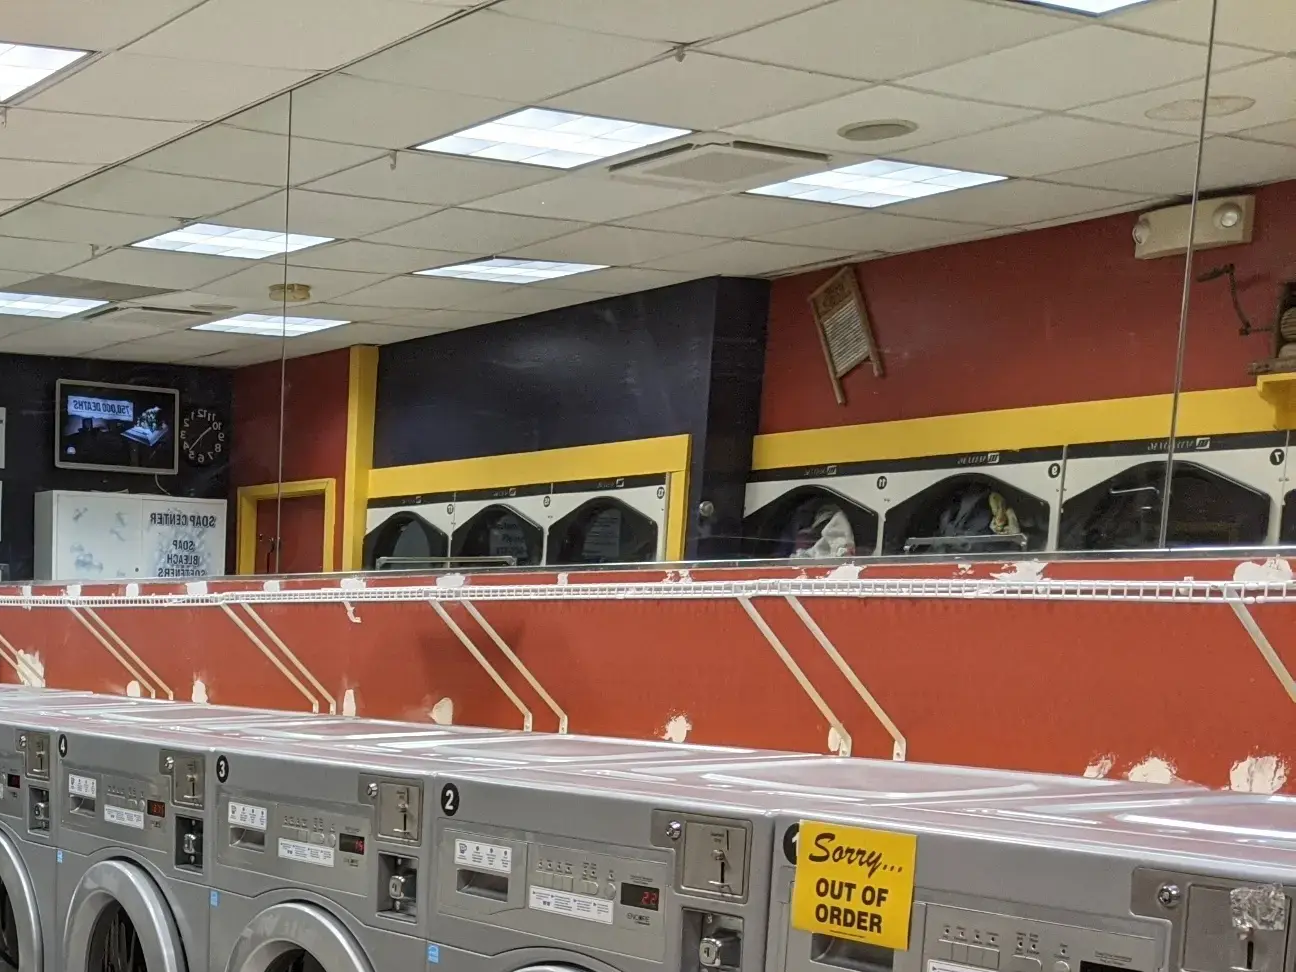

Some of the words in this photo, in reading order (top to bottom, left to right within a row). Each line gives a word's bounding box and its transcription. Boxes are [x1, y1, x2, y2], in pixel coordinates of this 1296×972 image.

[60, 739, 66, 753] 4
[219, 762, 226, 776] 3
[445, 790, 454, 810] 2
[809, 832, 903, 878] Sorry...
[816, 878, 856, 902] OUT
[862, 885, 889, 908] OF
[815, 903, 882, 934] ORDER
